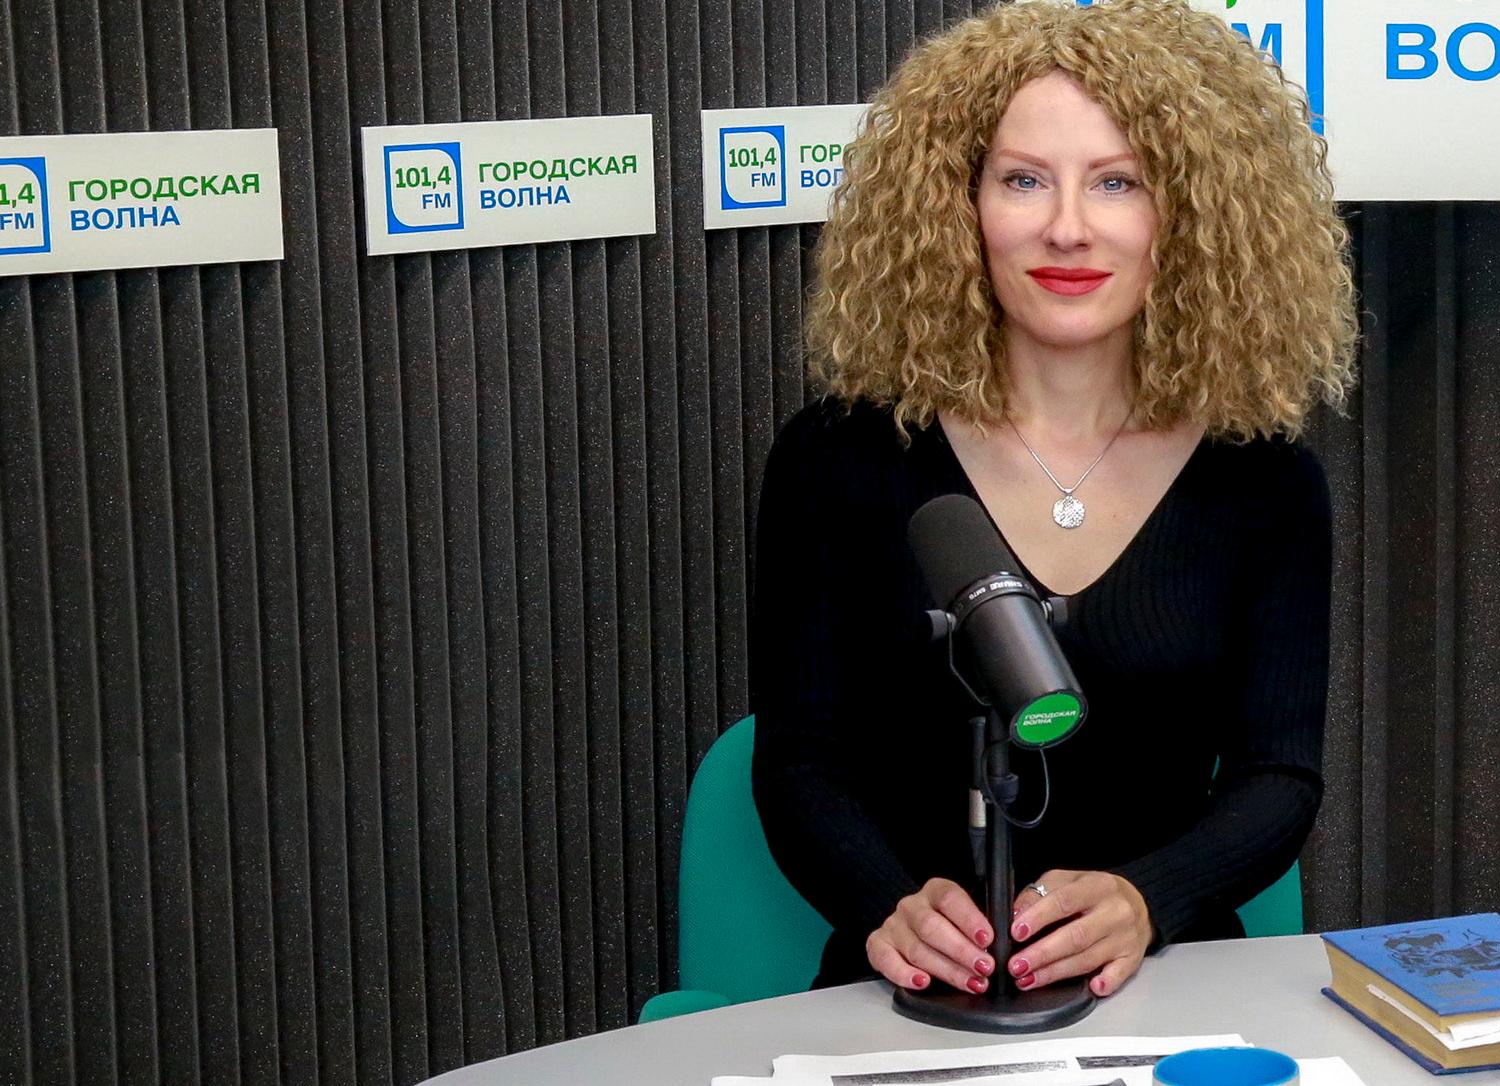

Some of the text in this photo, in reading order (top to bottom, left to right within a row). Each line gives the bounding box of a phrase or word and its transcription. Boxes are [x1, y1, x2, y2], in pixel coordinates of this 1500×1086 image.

[728, 147, 777, 169] 101,4
[799, 143, 846, 164] ГОР
[396, 165, 452, 189] 101,4
[479, 154, 638, 183] ГОРОДСКАЯ
[68, 173, 261, 202] ГОРОДСКАЯ
[752, 172, 776, 187] FM
[422, 191, 452, 209] FM
[480, 185, 571, 209] ВОЛНА
[0, 211, 35, 230] FM
[70, 204, 181, 232] ВОЛНА
[1022, 718, 1052, 727] ВОЛНА
[1025, 710, 1077, 720] ГОРОДСКАЯ
